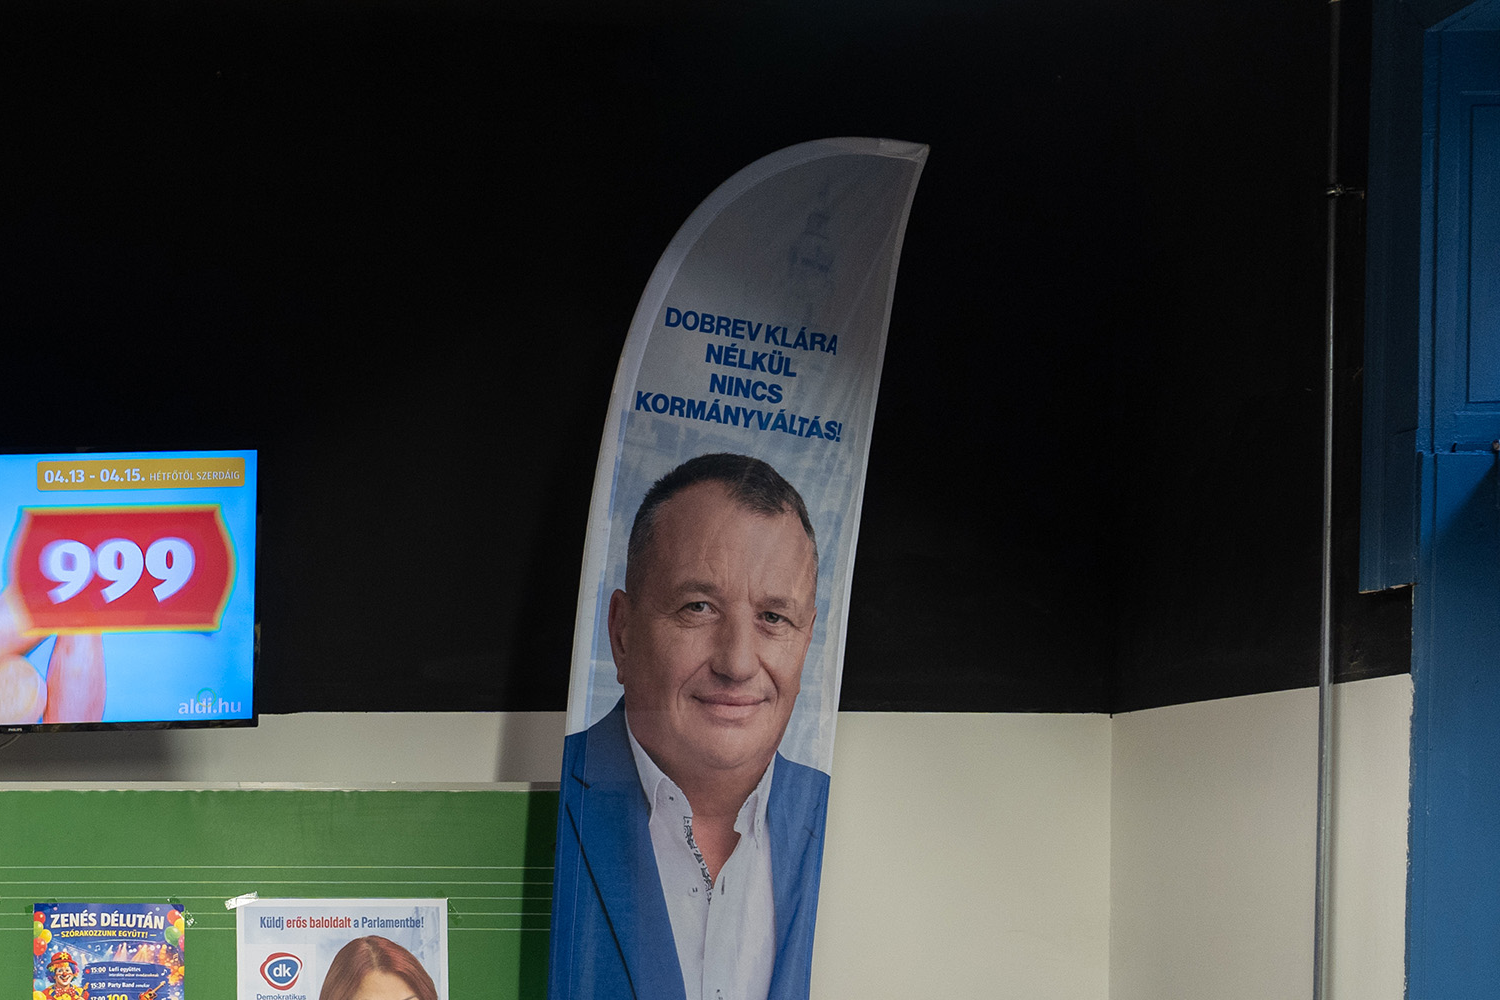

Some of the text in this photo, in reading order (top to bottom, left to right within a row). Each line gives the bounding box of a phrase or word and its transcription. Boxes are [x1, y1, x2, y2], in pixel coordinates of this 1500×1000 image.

[665, 307, 838, 356] DOBREV KLÁRA
[705, 343, 797, 377] NÉLKÜL
[709, 373, 783, 404] NINCS
[635, 391, 842, 442] KORMÁNYVÁLTÁS!
[44, 469, 85, 483] 04.13
[100, 468, 145, 482] 04.15.
[150, 470, 194, 481] HÉTFŐTŐL
[197, 469, 240, 480] SZERDÁIG
[40, 537, 196, 604] 999
[178, 697, 241, 714] aldi.hu
[50, 910, 165, 929] ZENÉS DÉLUTÁN
[260, 916, 424, 930] Küldj erős baloldalt a Parlamentbe!
[61, 929, 148, 938] SZÓRAKOZZUNK EGYÜTT!
[273, 963, 292, 977] dk
